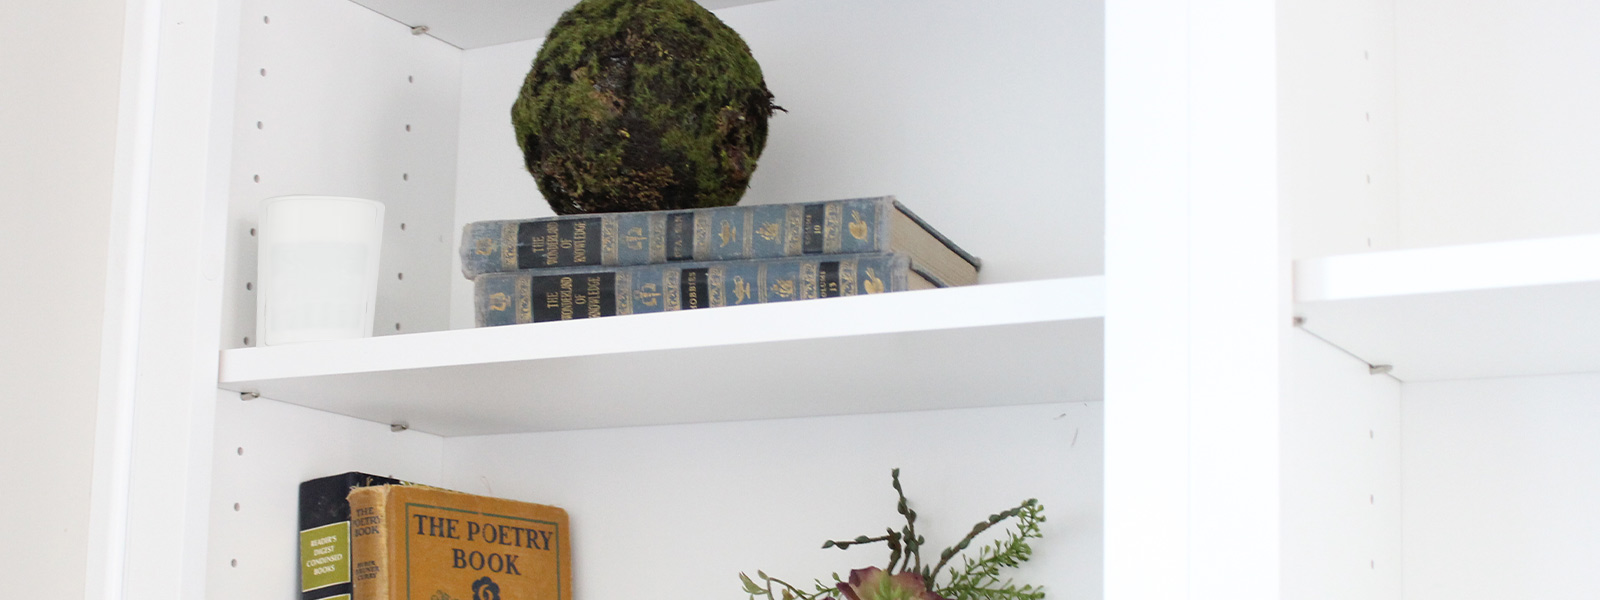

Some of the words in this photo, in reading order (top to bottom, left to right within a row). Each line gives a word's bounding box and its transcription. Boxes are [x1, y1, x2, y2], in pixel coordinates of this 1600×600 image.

[532, 235, 545, 253] THE
[546, 222, 558, 265] WONDERLAND
[561, 238, 573, 249] OF
[574, 221, 586, 263] KNOWLEDGE
[819, 270, 828, 298] OLUME
[546, 291, 559, 309] THE
[561, 277, 573, 320] WONDERLAND
[574, 293, 586, 305] OF
[587, 276, 601, 319] KNOWLEDGE
[356, 507, 374, 517] THE
[413, 514, 460, 540] THE
[467, 521, 553, 551] POETRY
[314, 546, 334, 556] DIGEST
[306, 554, 342, 568] CONDENSED
[314, 565, 335, 575] BOOKS
[452, 548, 522, 576] BOOK
